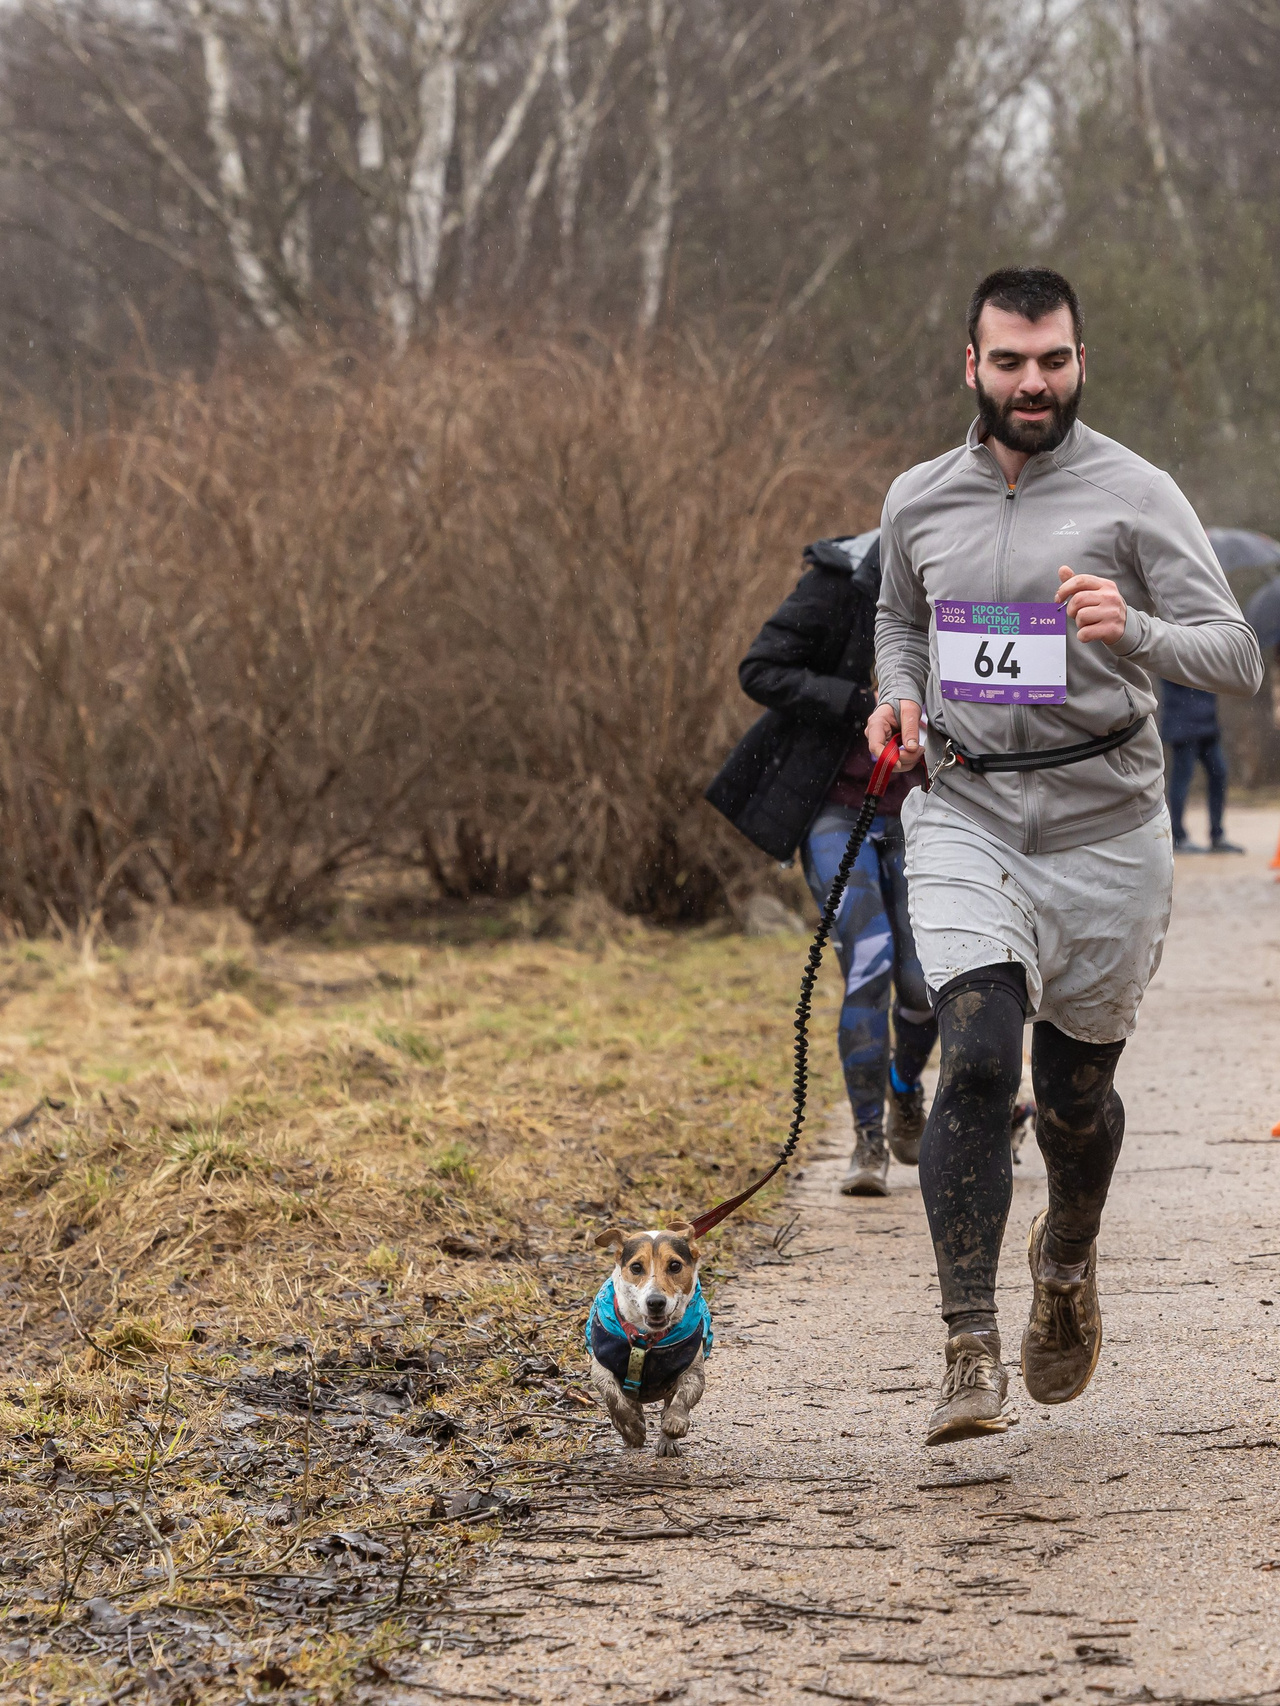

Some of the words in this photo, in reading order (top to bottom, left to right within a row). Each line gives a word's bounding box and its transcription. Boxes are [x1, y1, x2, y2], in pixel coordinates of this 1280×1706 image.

[941, 607, 966, 615] 11/04
[972, 605, 1010, 615] КРОСС
[942, 615, 966, 624] 2026
[972, 614, 1020, 626] БЫСТРЫЙ
[1030, 617, 1037, 625] 2
[974, 641, 1021, 679] 64
